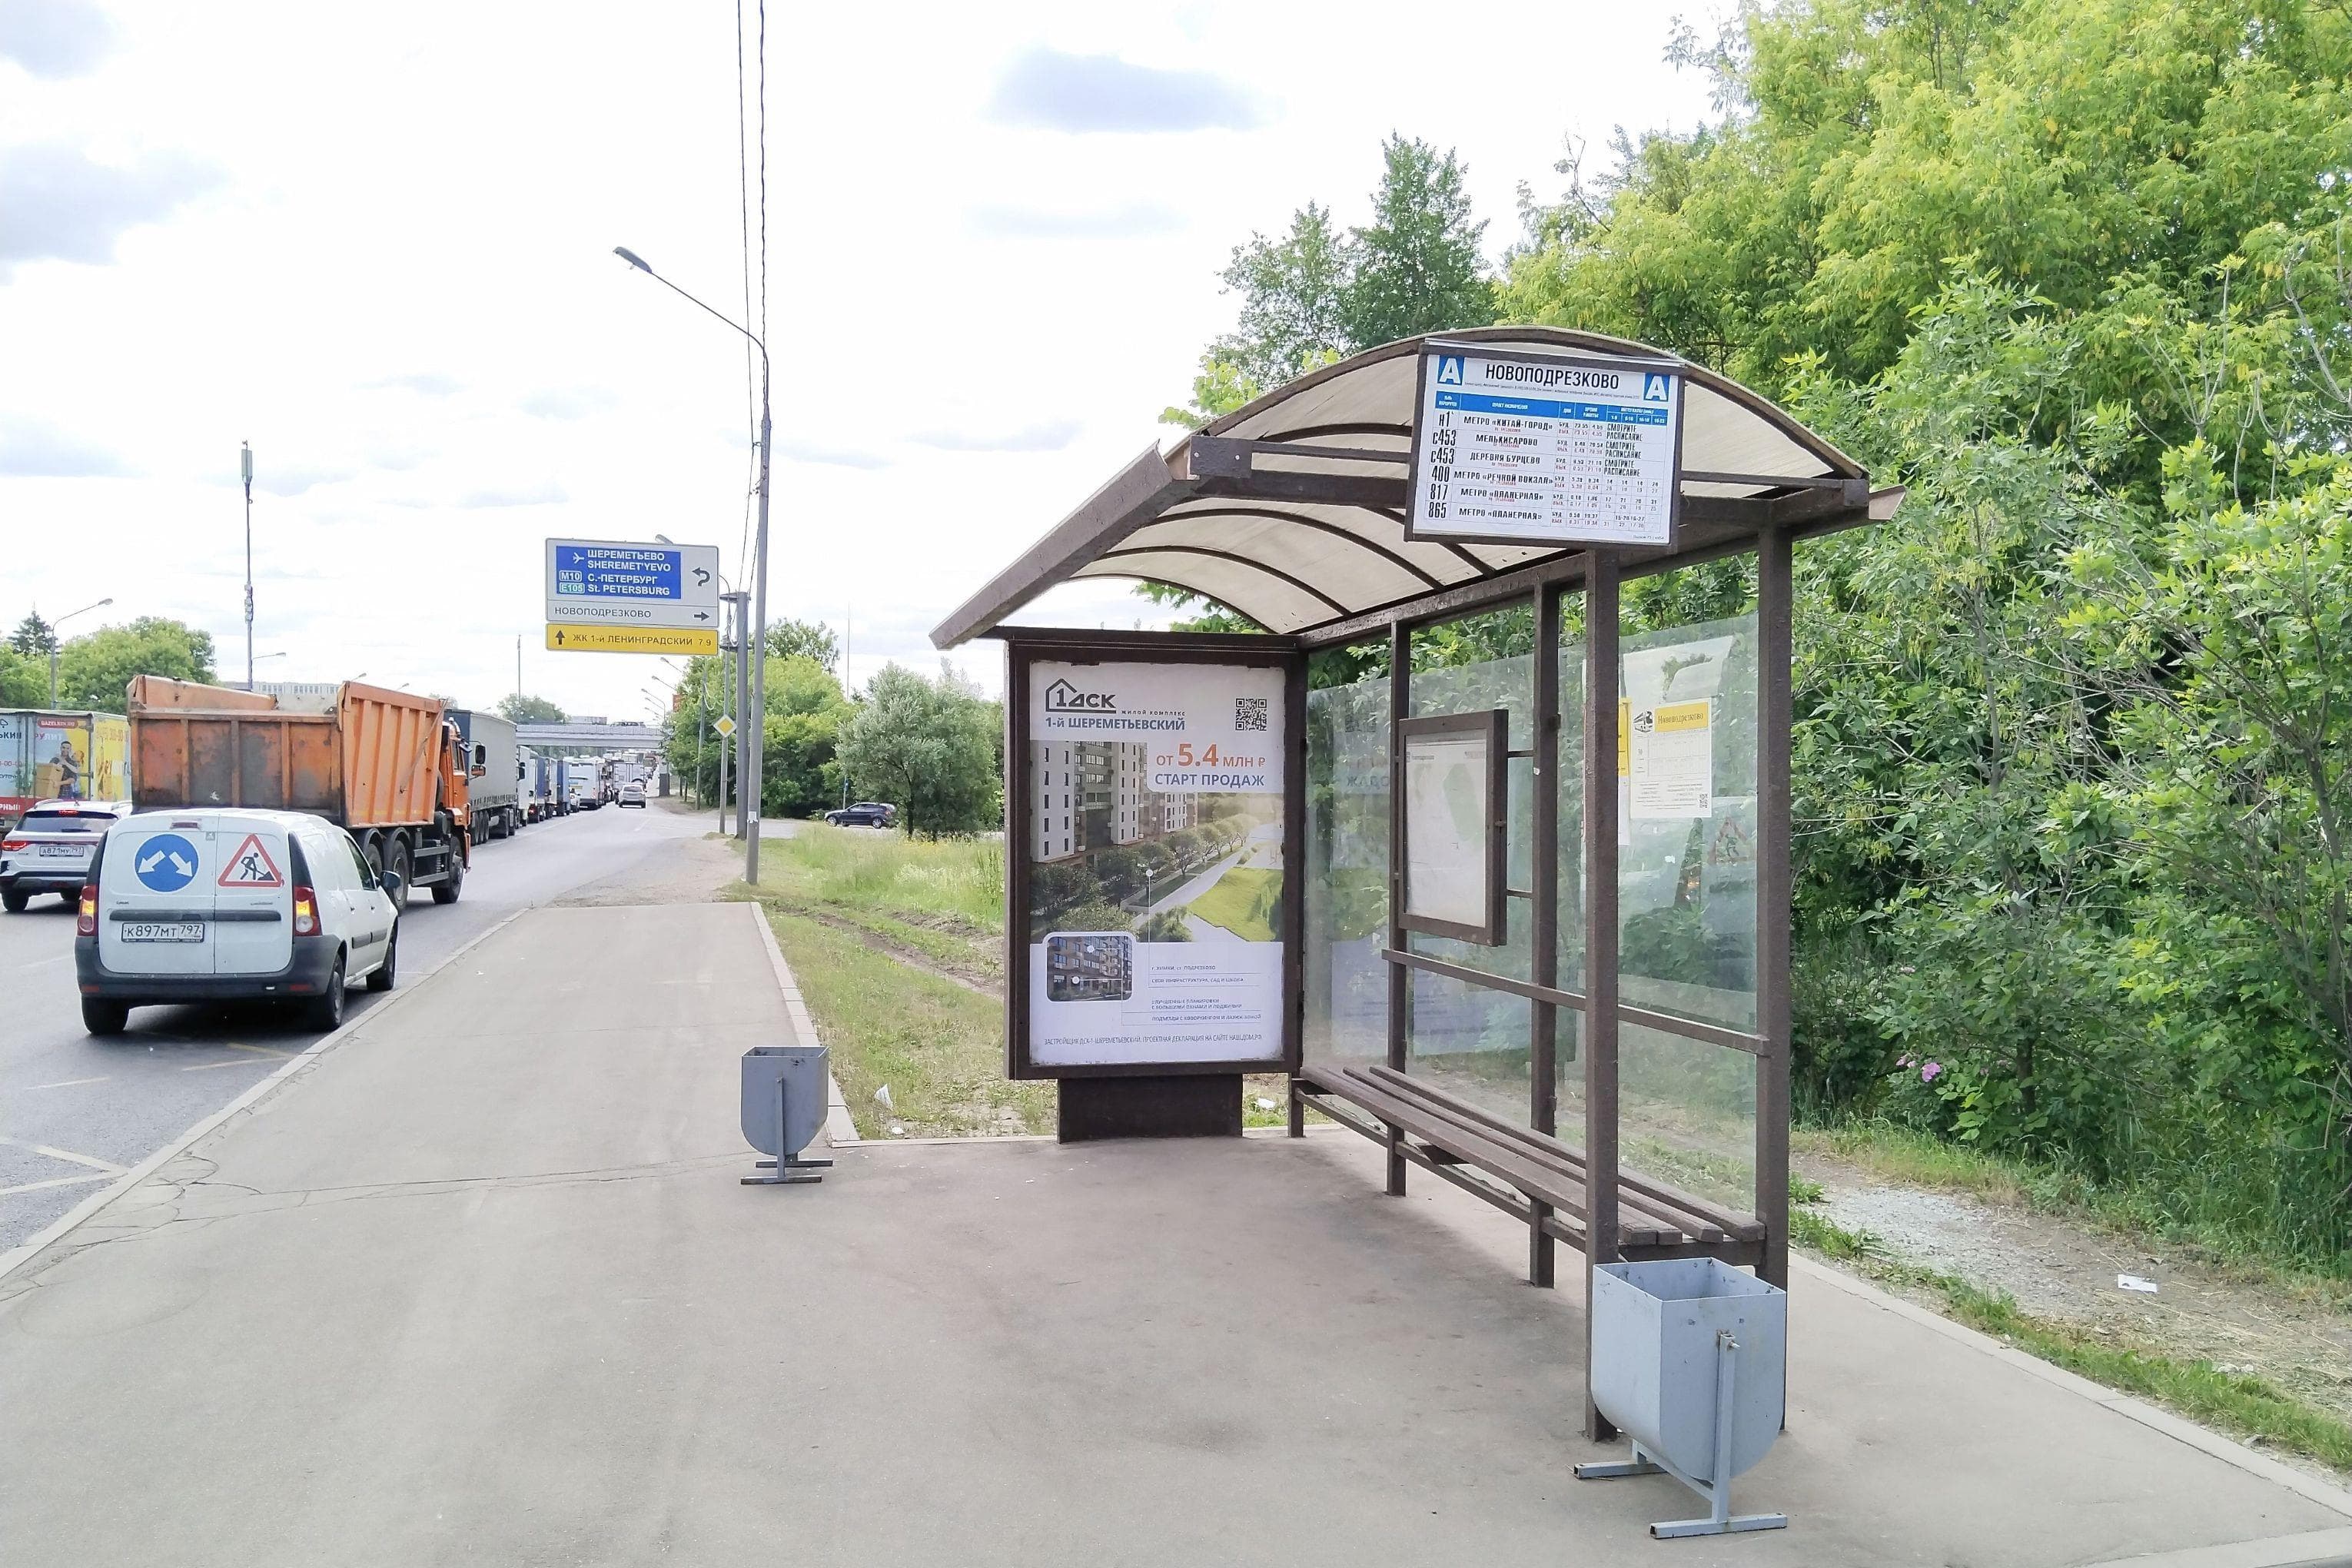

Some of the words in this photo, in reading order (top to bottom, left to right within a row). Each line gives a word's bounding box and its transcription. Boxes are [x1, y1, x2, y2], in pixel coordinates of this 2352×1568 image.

[1439, 357, 1461, 384] А
[1486, 364, 1619, 389] НОВОПОДРЕЗКОВО
[1645, 375, 1667, 400] А
[1463, 416, 1490, 426] МЕТРО
[1492, 418, 1553, 430] «КИТАЙ-ГОРОД»
[1606, 423, 1636, 433] СМОТРИТЕ
[1476, 434, 1538, 446] МЕЛЬКИСАРОВО
[1606, 432, 1643, 442] РАСПИСАНИЕ
[1606, 441, 1636, 450] СМОТРИТЕ
[1470, 452, 1504, 461] ДЕРЕВНЯ
[1507, 454, 1540, 464] БУРЦЕВО
[1605, 449, 1642, 459] РАСПИСАНИЕ
[1604, 459, 1634, 468] СМОТРИТЕ
[1431, 465, 1450, 482] 400
[1454, 470, 1480, 480] МЕТРО
[1482, 473, 1517, 482] «РЕЧНОЙ
[1518, 475, 1553, 484] ВОКЗАЛ»
[1603, 467, 1640, 477] РАСПИСАНИЕ
[1430, 483, 1448, 500] 817
[1460, 488, 1487, 497] МЕТРО
[1490, 490, 1543, 500] «ПЛАНЕРНАЯ»
[1428, 501, 1447, 519] 865
[1459, 508, 1486, 517] МЕТРО
[1487, 510, 1542, 520] «ПЛАНЕРНАЯ»
[588, 549, 665, 561] ШЕРЕМЕТЬЕВО
[587, 560, 671, 572] SHEREMET'YEVO
[587, 573, 658, 584] С.-ПЕТЕРБУРГ
[587, 583, 600, 593] St.
[603, 586, 670, 596] PETERSBURG
[555, 607, 652, 618] НОВОПОДРЕЗКОВО
[608, 635, 693, 646] ЛЕНИНГРАДСКИЙ
[1045, 717, 1065, 728] 1-й
[1068, 717, 1185, 731] ШЕРЕМЕТЬЕВСКИЙ
[1178, 743, 1219, 767] 5.4
[1223, 756, 1254, 767] МЛН
[1155, 773, 1197, 786] СТАРТ
[1201, 774, 1264, 789] ПРОДАЖ
[127, 925, 178, 937] К897МТ
[180, 925, 200, 934] 797
[1172, 1035, 1204, 1043] ДЕКЛАРАЦИЯ
